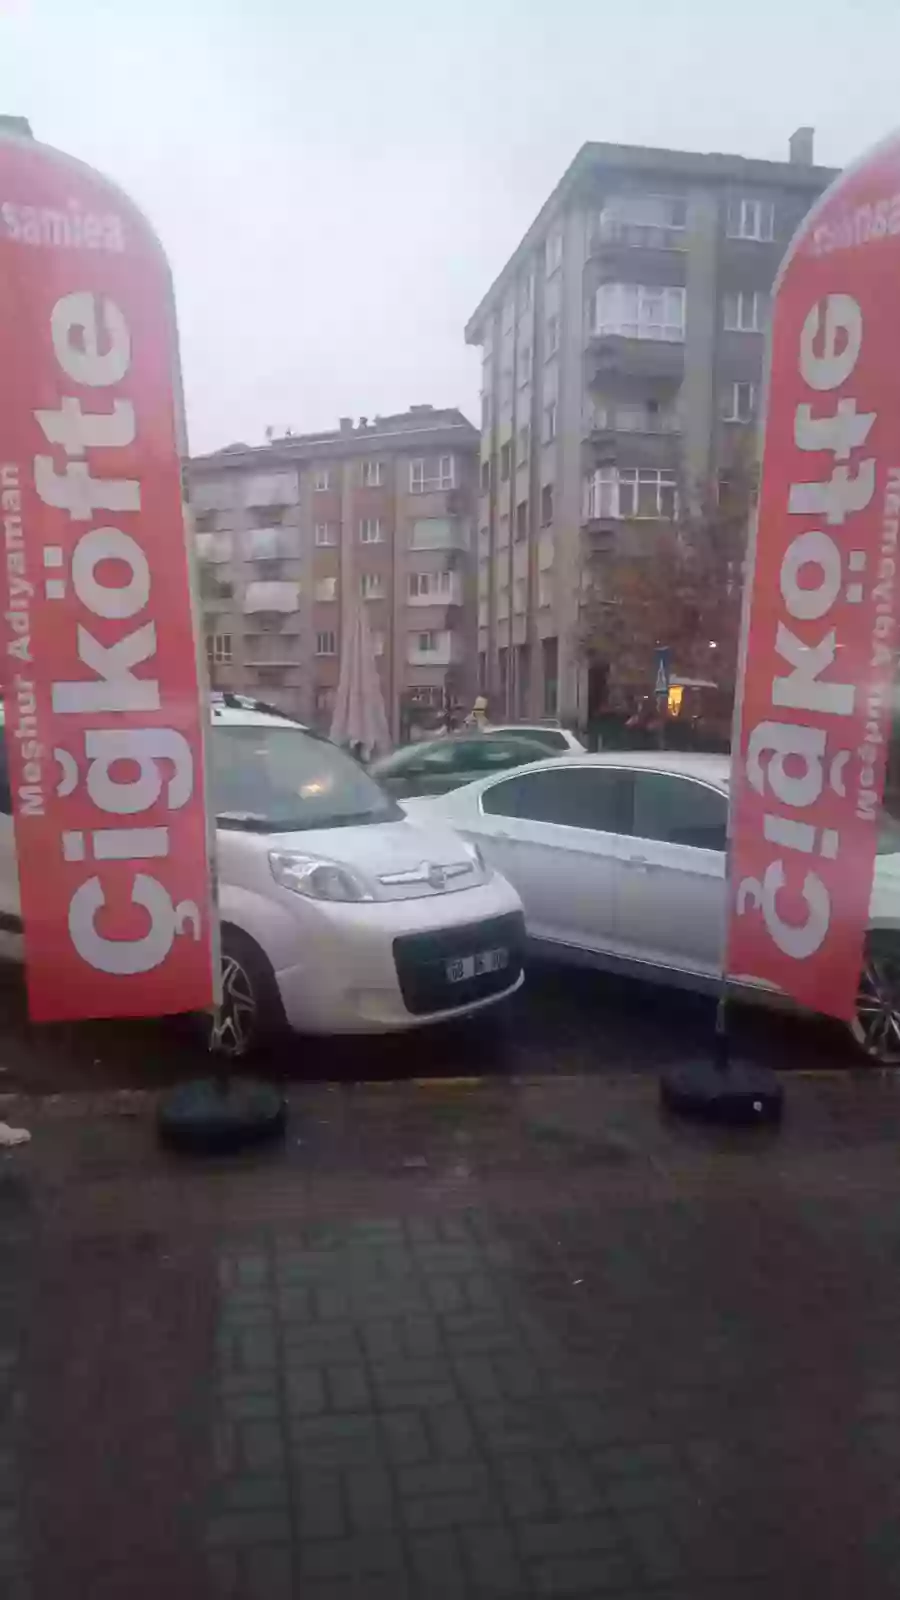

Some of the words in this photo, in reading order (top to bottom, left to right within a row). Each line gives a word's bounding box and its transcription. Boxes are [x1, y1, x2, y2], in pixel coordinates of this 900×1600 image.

[0, 464, 34, 662] Adıyaman
[34, 291, 200, 975] Çiğköfte
[14, 673, 46, 816] Meşhur
